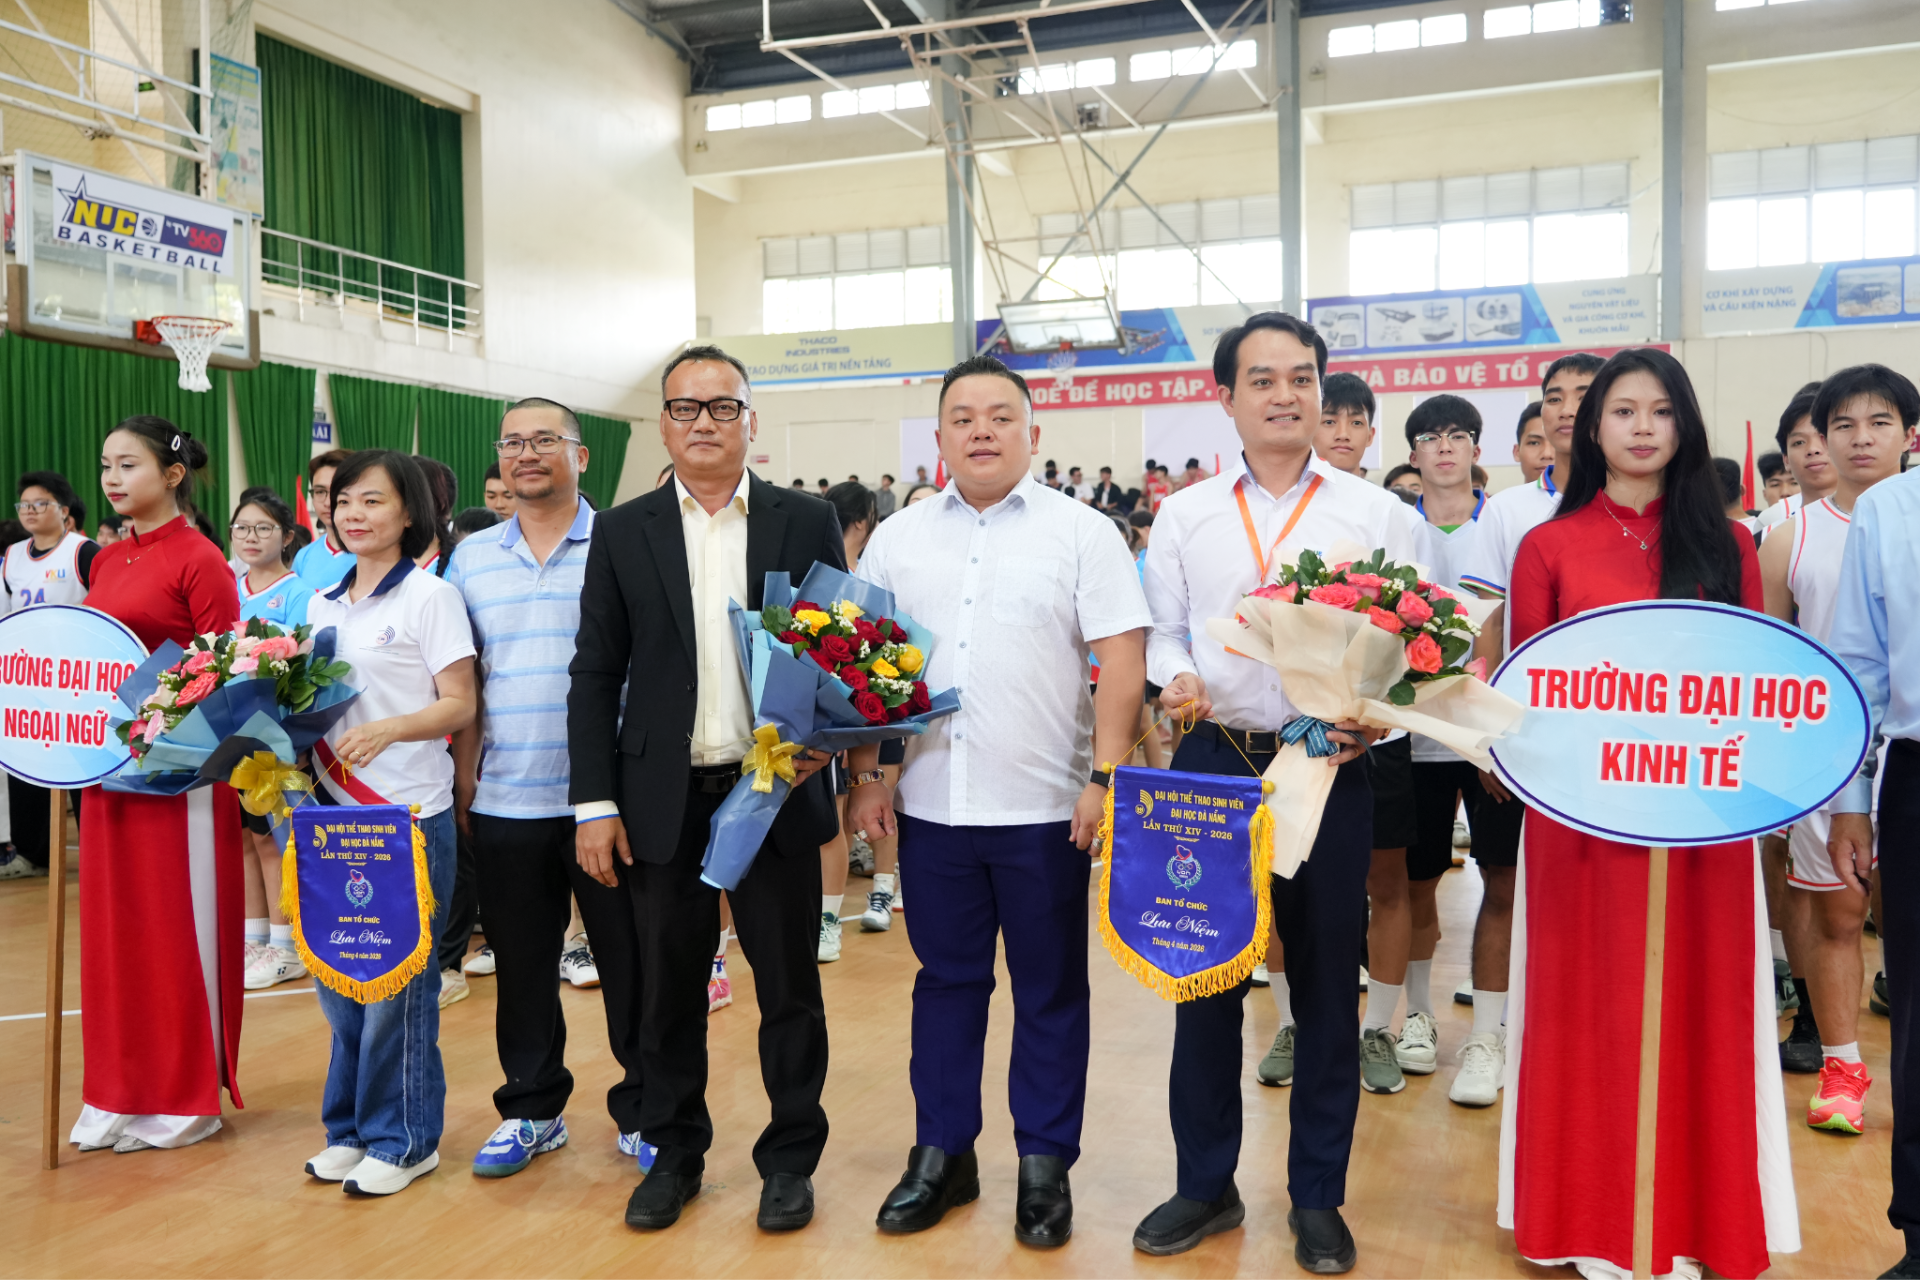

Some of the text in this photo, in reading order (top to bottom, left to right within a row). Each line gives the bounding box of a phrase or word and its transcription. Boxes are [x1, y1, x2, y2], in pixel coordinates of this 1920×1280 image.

[58, 226, 221, 273] BASKETBALL
[798, 336, 838, 346] THACO
[785, 346, 850, 357] INDUSTRIES
[1106, 382, 1153, 404] HỌC
[1159, 376, 1212, 400] TẬP,
[1393, 362, 1447, 387] BẢO
[1454, 360, 1487, 387] VỆ
[1495, 355, 1530, 382] TỔ
[45, 569, 66, 579] VKU
[0, 648, 54, 689] ƯỜNG
[58, 658, 91, 697] ĐẠI
[1526, 661, 1828, 728] TRƯỜNG ĐẠI HỌC
[4, 707, 109, 748] NGOẠI NGỮ
[1600, 734, 1745, 788] KINH TẾ
[1155, 789, 1244, 810] ĐẠI HỘI THỂ THAO SINH VIÊN
[1171, 808, 1183, 820] ĐẠI
[1183, 809, 1197, 821] HỌC
[1198, 809, 1207, 822] ĐÀ
[357, 824, 371, 834] THAO
[372, 824, 384, 834] SINH
[384, 822, 397, 834] VIÊN
[1143, 818, 1161, 831] LẦN
[1163, 823, 1183, 834] THỨ
[1185, 826, 1202, 836] XIV
[1210, 830, 1233, 840] 2026
[351, 838, 362, 849] HỌC
[1156, 896, 1208, 912] BAN TỔ CHỨC
[353, 914, 363, 923] TỔ
[364, 916, 381, 924] CHỨC
[1138, 910, 1220, 938] Lưu Niệm
[329, 929, 392, 947] Lưu Niệm
[1152, 937, 1171, 949] Tháng
[1171, 940, 1176, 948] 4
[1176, 942, 1189, 950] năm
